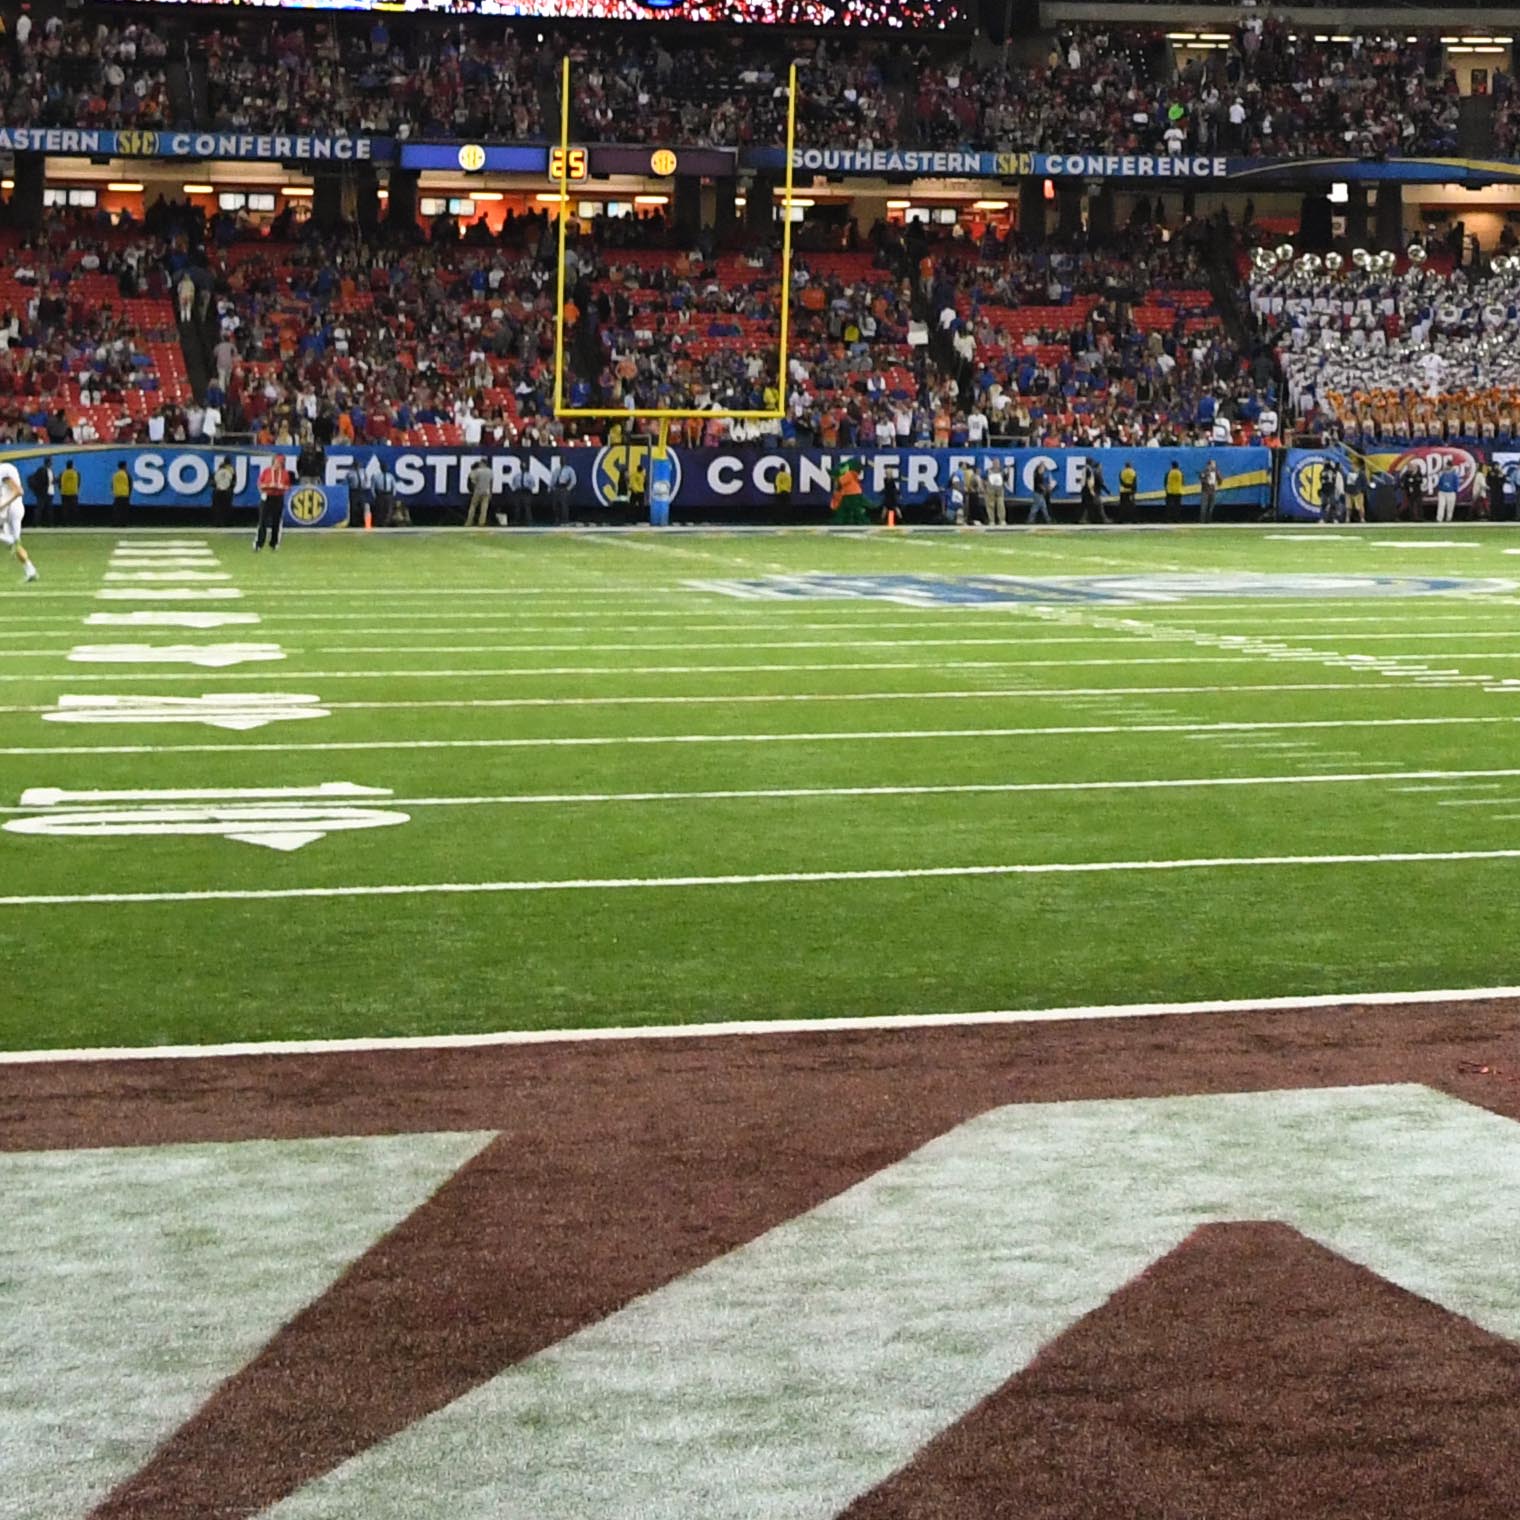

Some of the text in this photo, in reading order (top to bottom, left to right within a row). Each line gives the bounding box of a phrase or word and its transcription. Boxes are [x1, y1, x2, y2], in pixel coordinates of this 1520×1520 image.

[0, 129, 99, 151] ASTERN
[172, 134, 372, 160] CONFERENCE
[792, 148, 981, 172] SOUTHEASTERN
[1046, 154, 1228, 177] CONFERENCE
[291, 488, 325, 519] SEC
